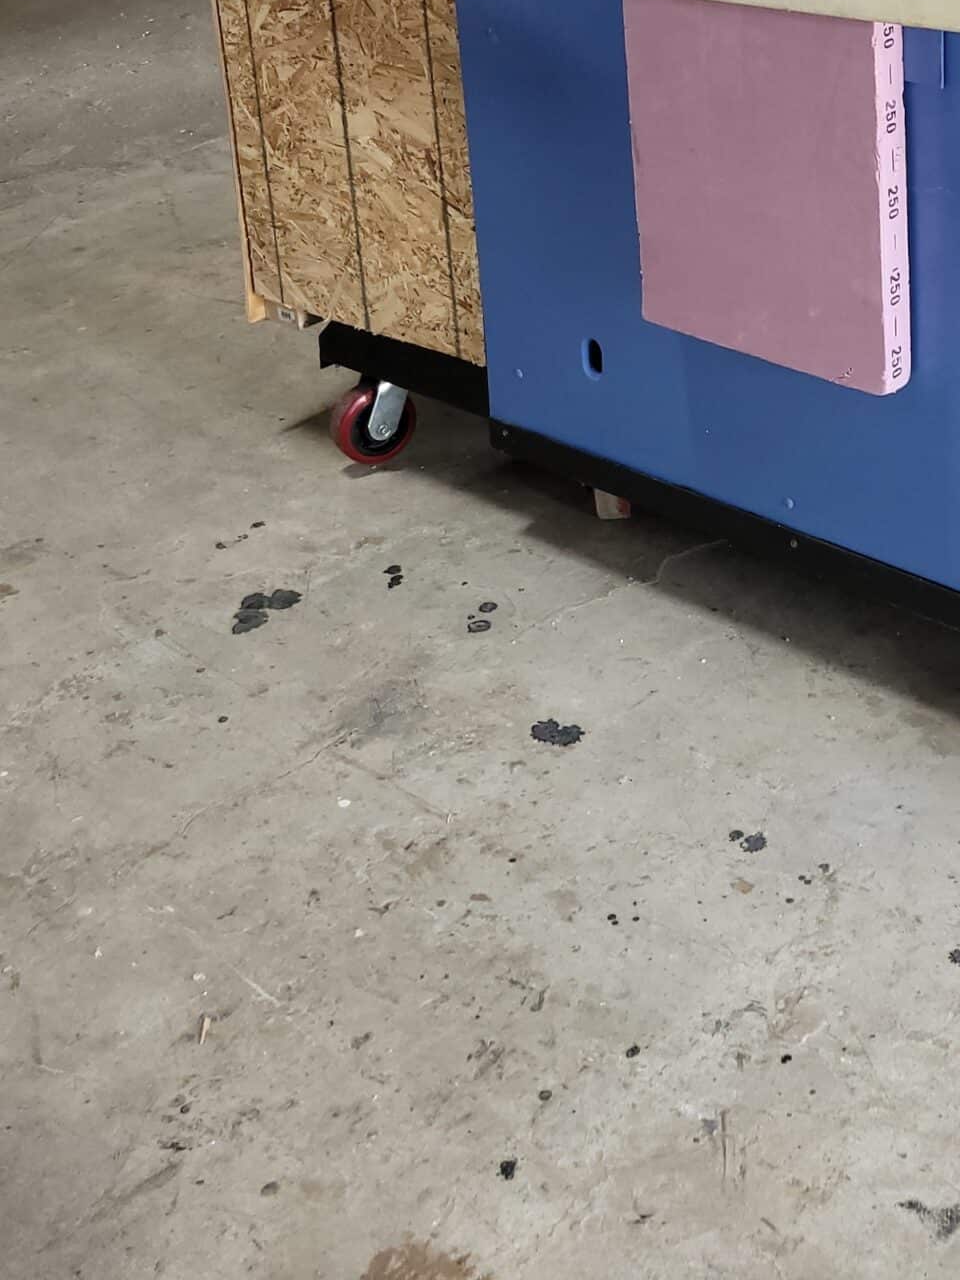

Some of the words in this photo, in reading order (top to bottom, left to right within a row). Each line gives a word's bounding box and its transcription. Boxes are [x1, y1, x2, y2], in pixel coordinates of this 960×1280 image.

[882, 20, 895, 49] 50
[885, 99, 897, 134] 250
[887, 184, 899, 220] 250
[890, 272, 901, 307] 250
[891, 345, 902, 380] 250
